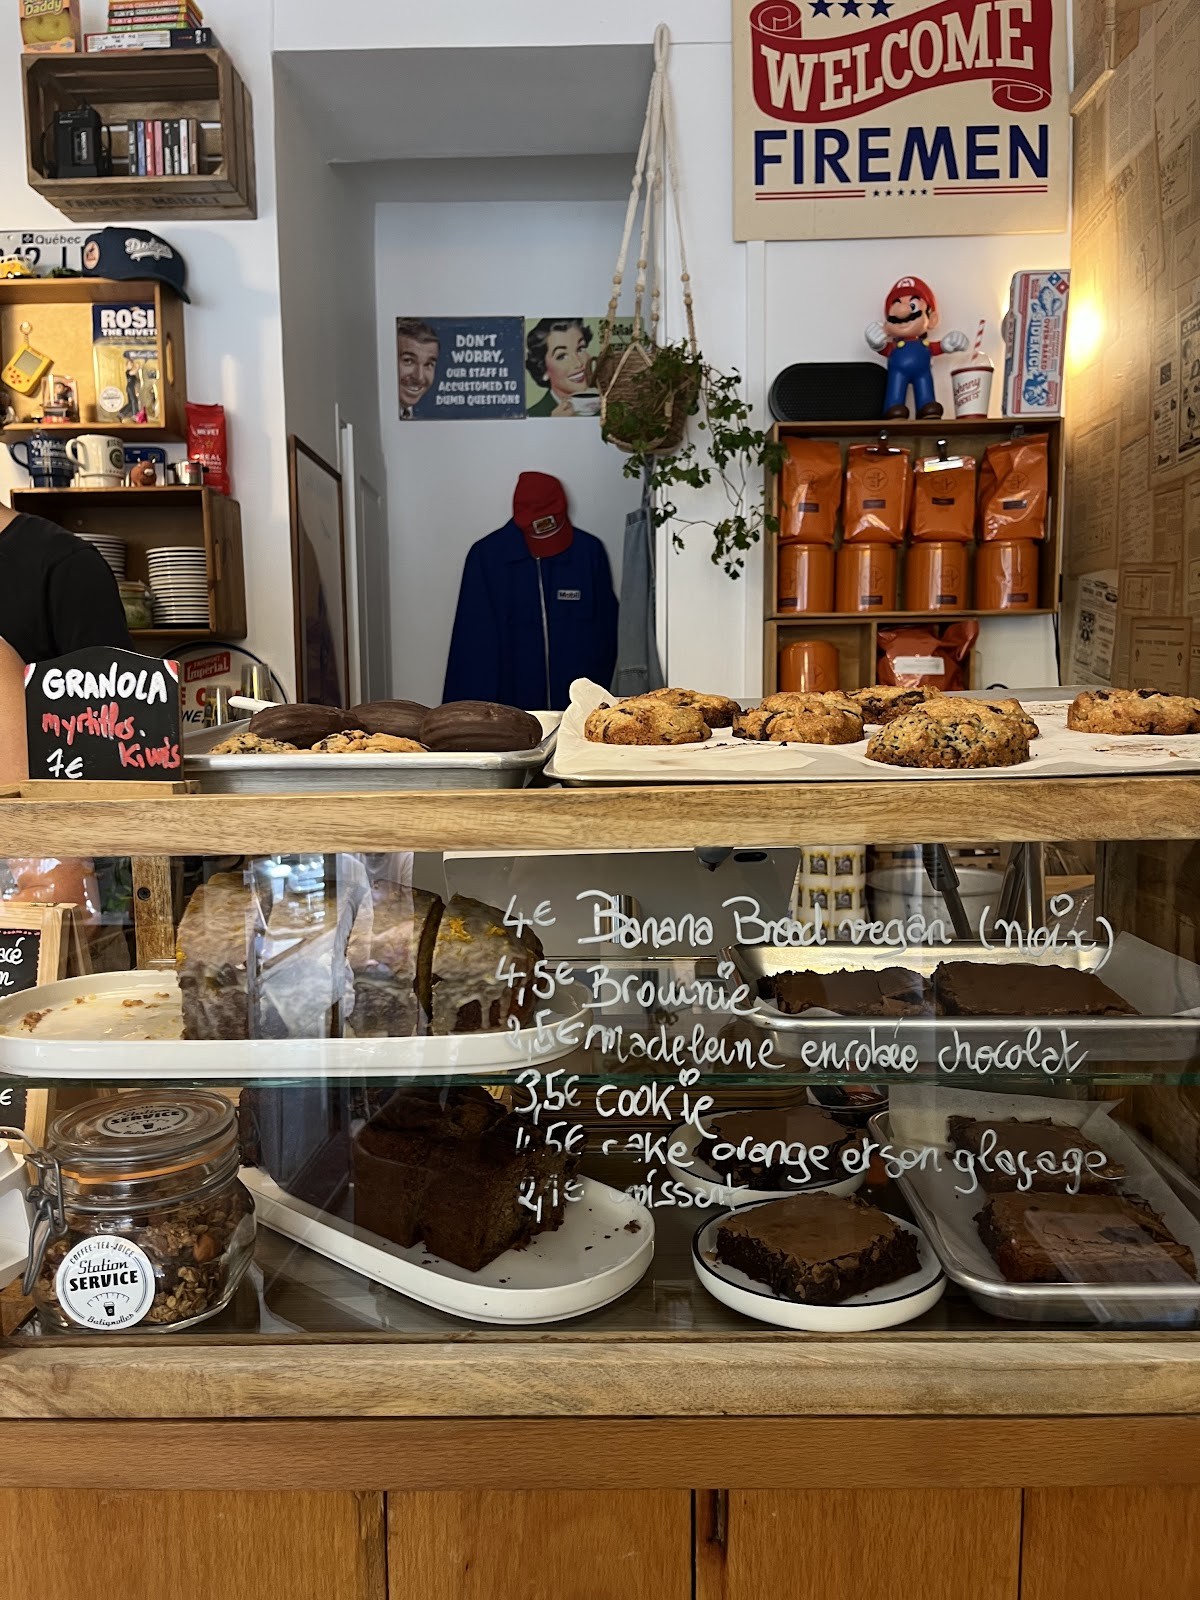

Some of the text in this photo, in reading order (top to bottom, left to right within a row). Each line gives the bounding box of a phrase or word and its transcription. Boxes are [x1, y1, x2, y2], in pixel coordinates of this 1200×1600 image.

[25, 0, 62, 15] Daddy
[760, 0, 1034, 112] WELCOME
[754, 124, 1049, 186] FIREMEN
[35, 234, 81, 245] Québec
[101, 309, 155, 329] ROSI
[102, 327, 157, 337] THE RIVET
[456, 334, 498, 348] DON'T
[451, 350, 505, 364] WORRY,
[446, 367, 508, 378] OUR STAFF IS
[438, 381, 517, 392] ACCUSTOMED TO
[436, 394, 520, 406] DUMB QUESTIONS
[186, 657, 229, 680] Imperial
[42, 662, 168, 704] GRANOLA
[46, 748, 84, 779] 7€
[502, 894, 556, 938] 4€
[576, 889, 714, 949] Banana
[839, 913, 953, 960] vegan
[495, 955, 762, 1016] 4,5€ Brownie
[937, 1026, 1089, 1075] chocolat
[514, 1068, 582, 1125] 3,5€
[110, 1111, 180, 1125] SERVICE
[711, 1136, 830, 1184] orange
[952, 1129, 1132, 1195] glaçage
[69, 1241, 136, 1264] COFFEE-TEA-JUICE
[78, 1258, 129, 1275] Station
[69, 1270, 139, 1292] SERVICE
